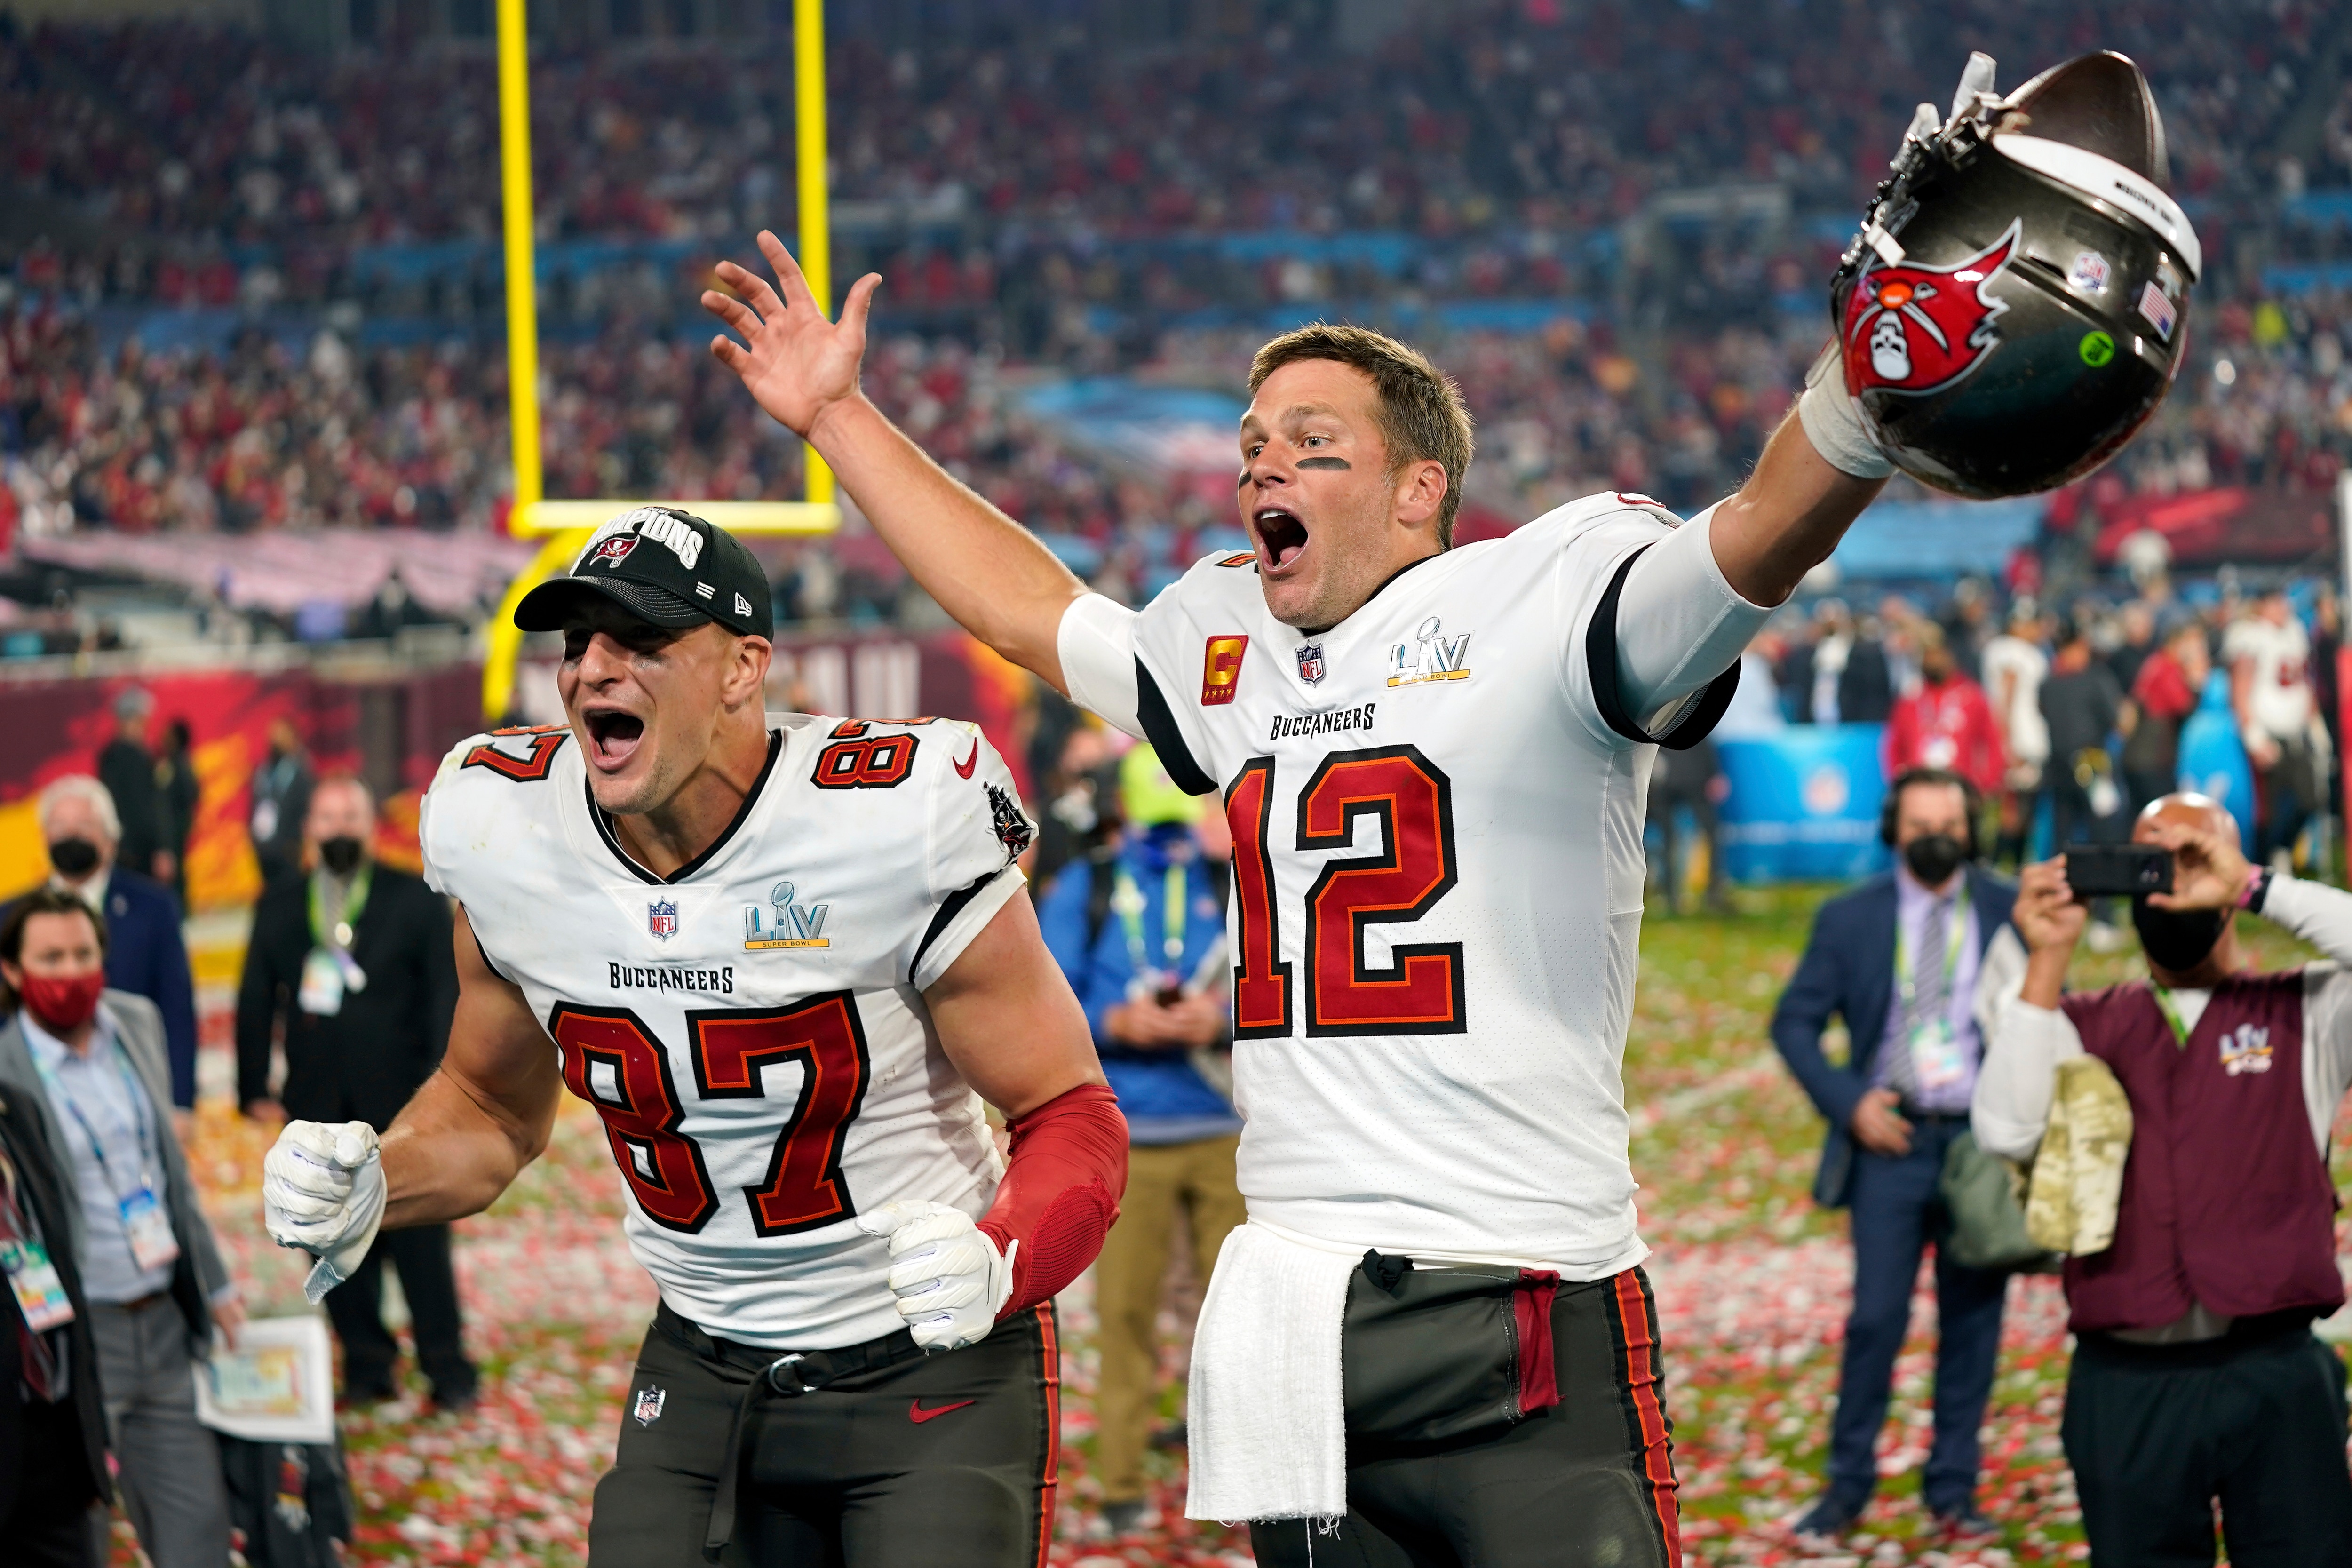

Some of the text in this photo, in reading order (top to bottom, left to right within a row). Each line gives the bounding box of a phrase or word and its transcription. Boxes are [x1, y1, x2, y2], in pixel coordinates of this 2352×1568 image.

[569, 509, 704, 578] MPIONS
[1207, 639, 1242, 685] C
[1301, 660, 1322, 680] NFL
[1270, 703, 1375, 740] BUCCANEERS
[1224, 744, 1467, 1040] 12
[652, 916, 674, 933] NFL
[608, 961, 733, 995] BUCCANEERS
[548, 988, 871, 1238] 87
